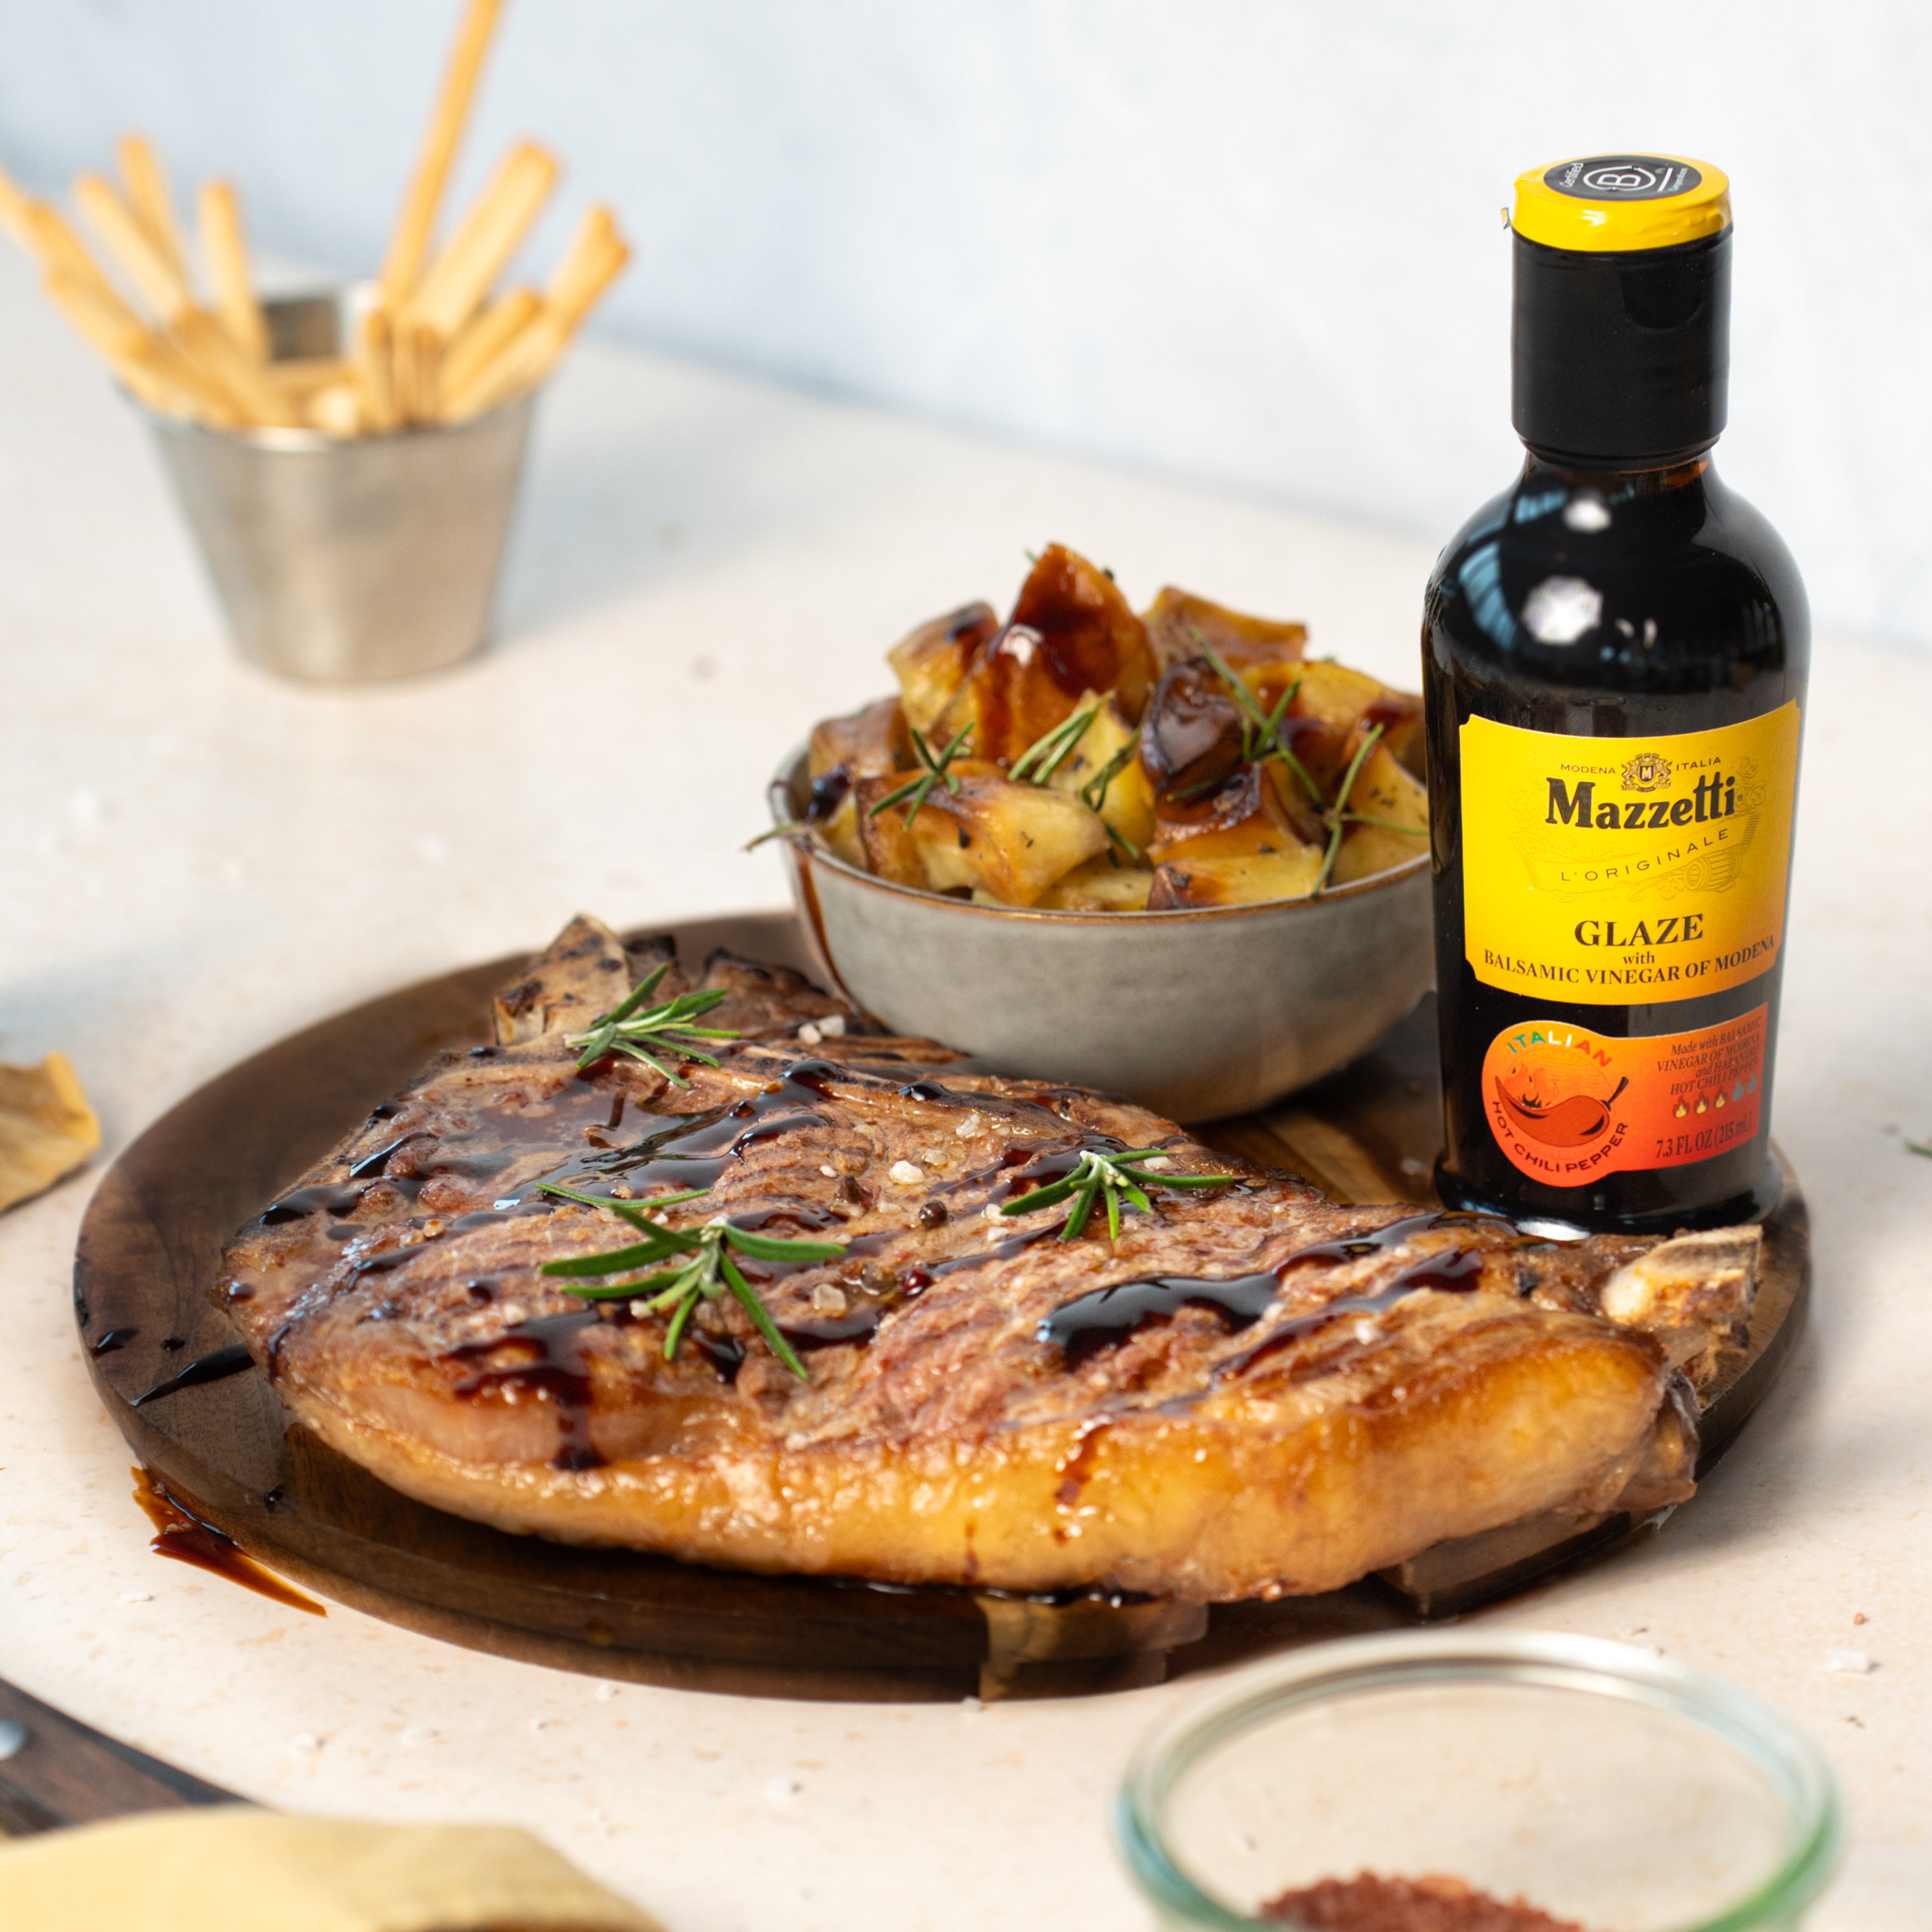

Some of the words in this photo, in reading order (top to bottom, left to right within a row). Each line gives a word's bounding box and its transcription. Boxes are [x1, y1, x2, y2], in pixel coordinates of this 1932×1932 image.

[1560, 763, 1616, 774] MODENA
[1676, 757, 1721, 771] ITALIA
[1641, 766, 1652, 779] M
[1545, 771, 1735, 829] Mazzetti
[1561, 828, 1729, 882] L'ORIGINALE
[1574, 913, 1703, 947] GLAZE
[1484, 949, 1579, 983] BALSAMIC
[1584, 965, 1681, 984] VINEGAR
[1685, 960, 1711, 978] OF
[1714, 934, 1775, 973] MODENA
[1623, 951, 1655, 964] with
[1507, 1030, 1613, 1068] ITALIAN
[1657, 1052, 1708, 1072] VINEGAR
[1710, 1048, 1724, 1062] OF
[1726, 1032, 1760, 1055] MODENA
[1671, 1040, 1697, 1056] Made
[1699, 1035, 1718, 1050] with
[1719, 1016, 1762, 1045] BALSAMIC
[1670, 1081, 1696, 1095] HOT
[1697, 1071, 1727, 1089] CHILI
[1695, 1063, 1712, 1078] and
[1492, 1101, 1514, 1139] HOT
[1514, 1143, 1559, 1173] CHILI
[1566, 1122, 1628, 1173] PEPPER
[1656, 1138, 1673, 1158] 7.3
[1676, 1135, 1692, 1155] FL
[1695, 1129, 1712, 1151] OZ
[1715, 1121, 1734, 1148] (215
